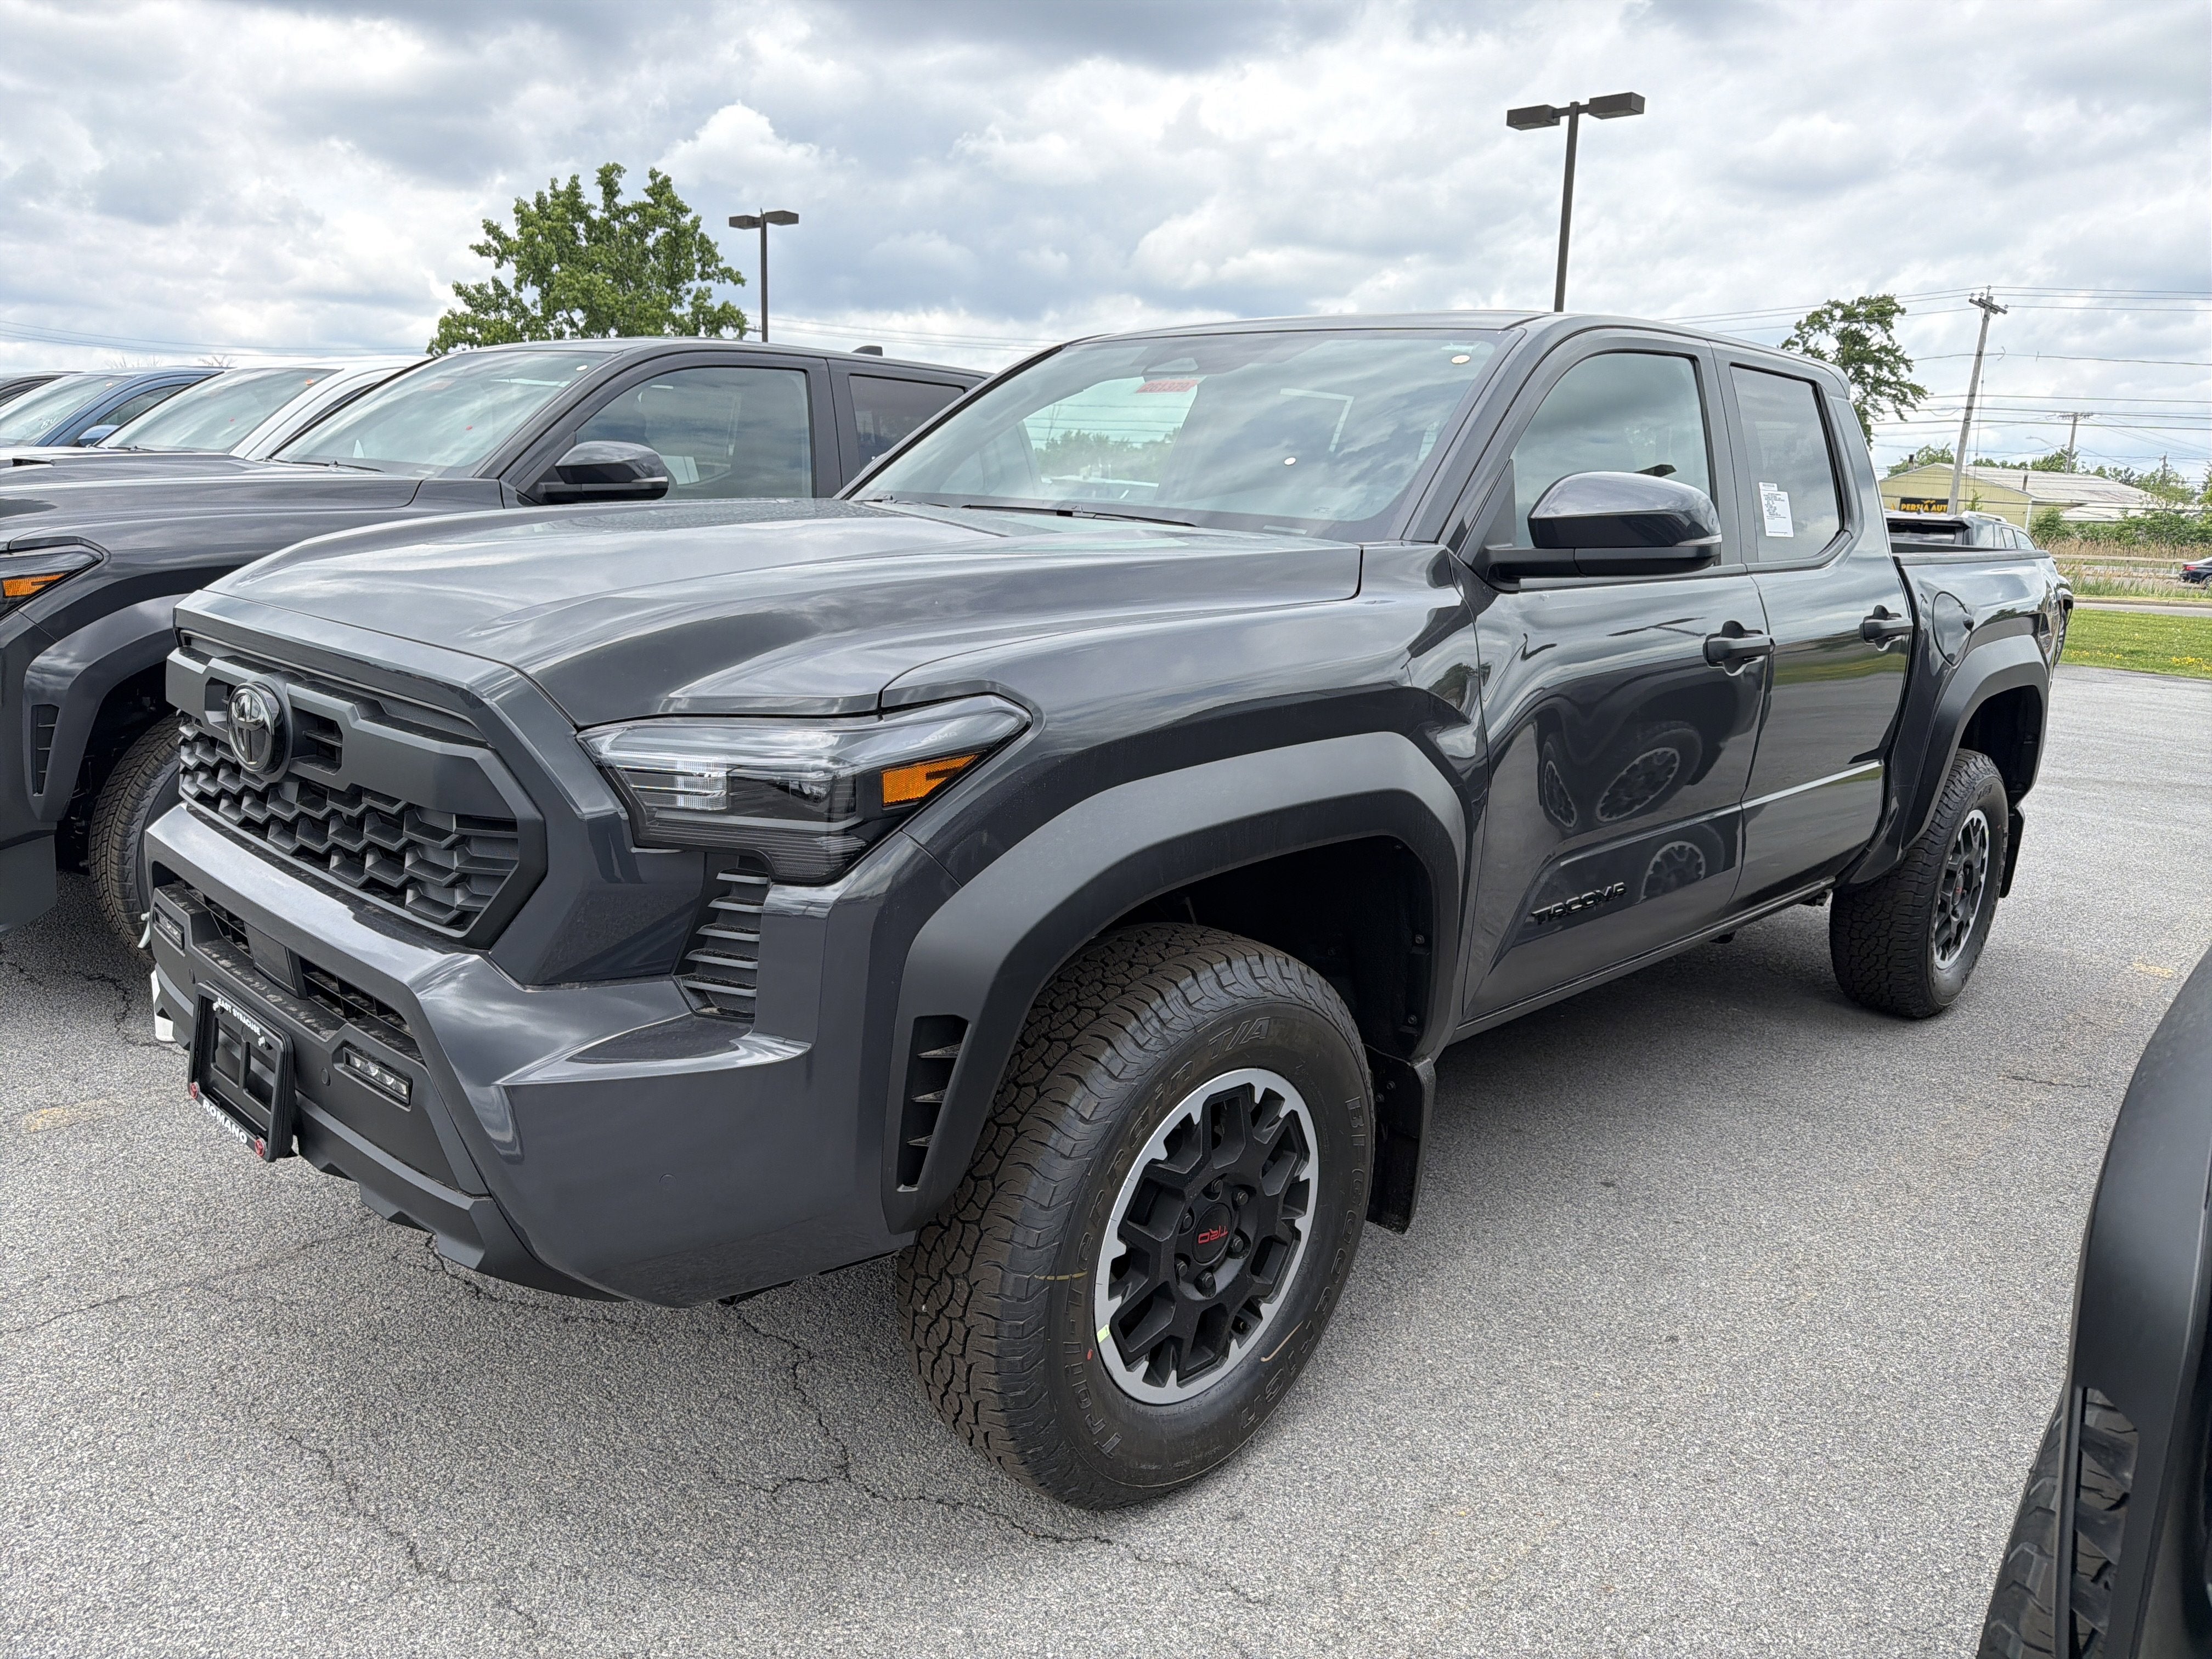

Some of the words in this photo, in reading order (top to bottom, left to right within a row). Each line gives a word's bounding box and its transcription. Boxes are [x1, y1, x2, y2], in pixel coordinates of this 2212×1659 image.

[1531, 882, 1627, 924] TACOMA
[217, 997, 232, 1013] EAST
[232, 1008, 261, 1036] SYRACUSE
[1207, 1017, 1271, 1060] T/A
[202, 1099, 247, 1144] ROMANO
[1198, 1225, 1228, 1244] TRD
